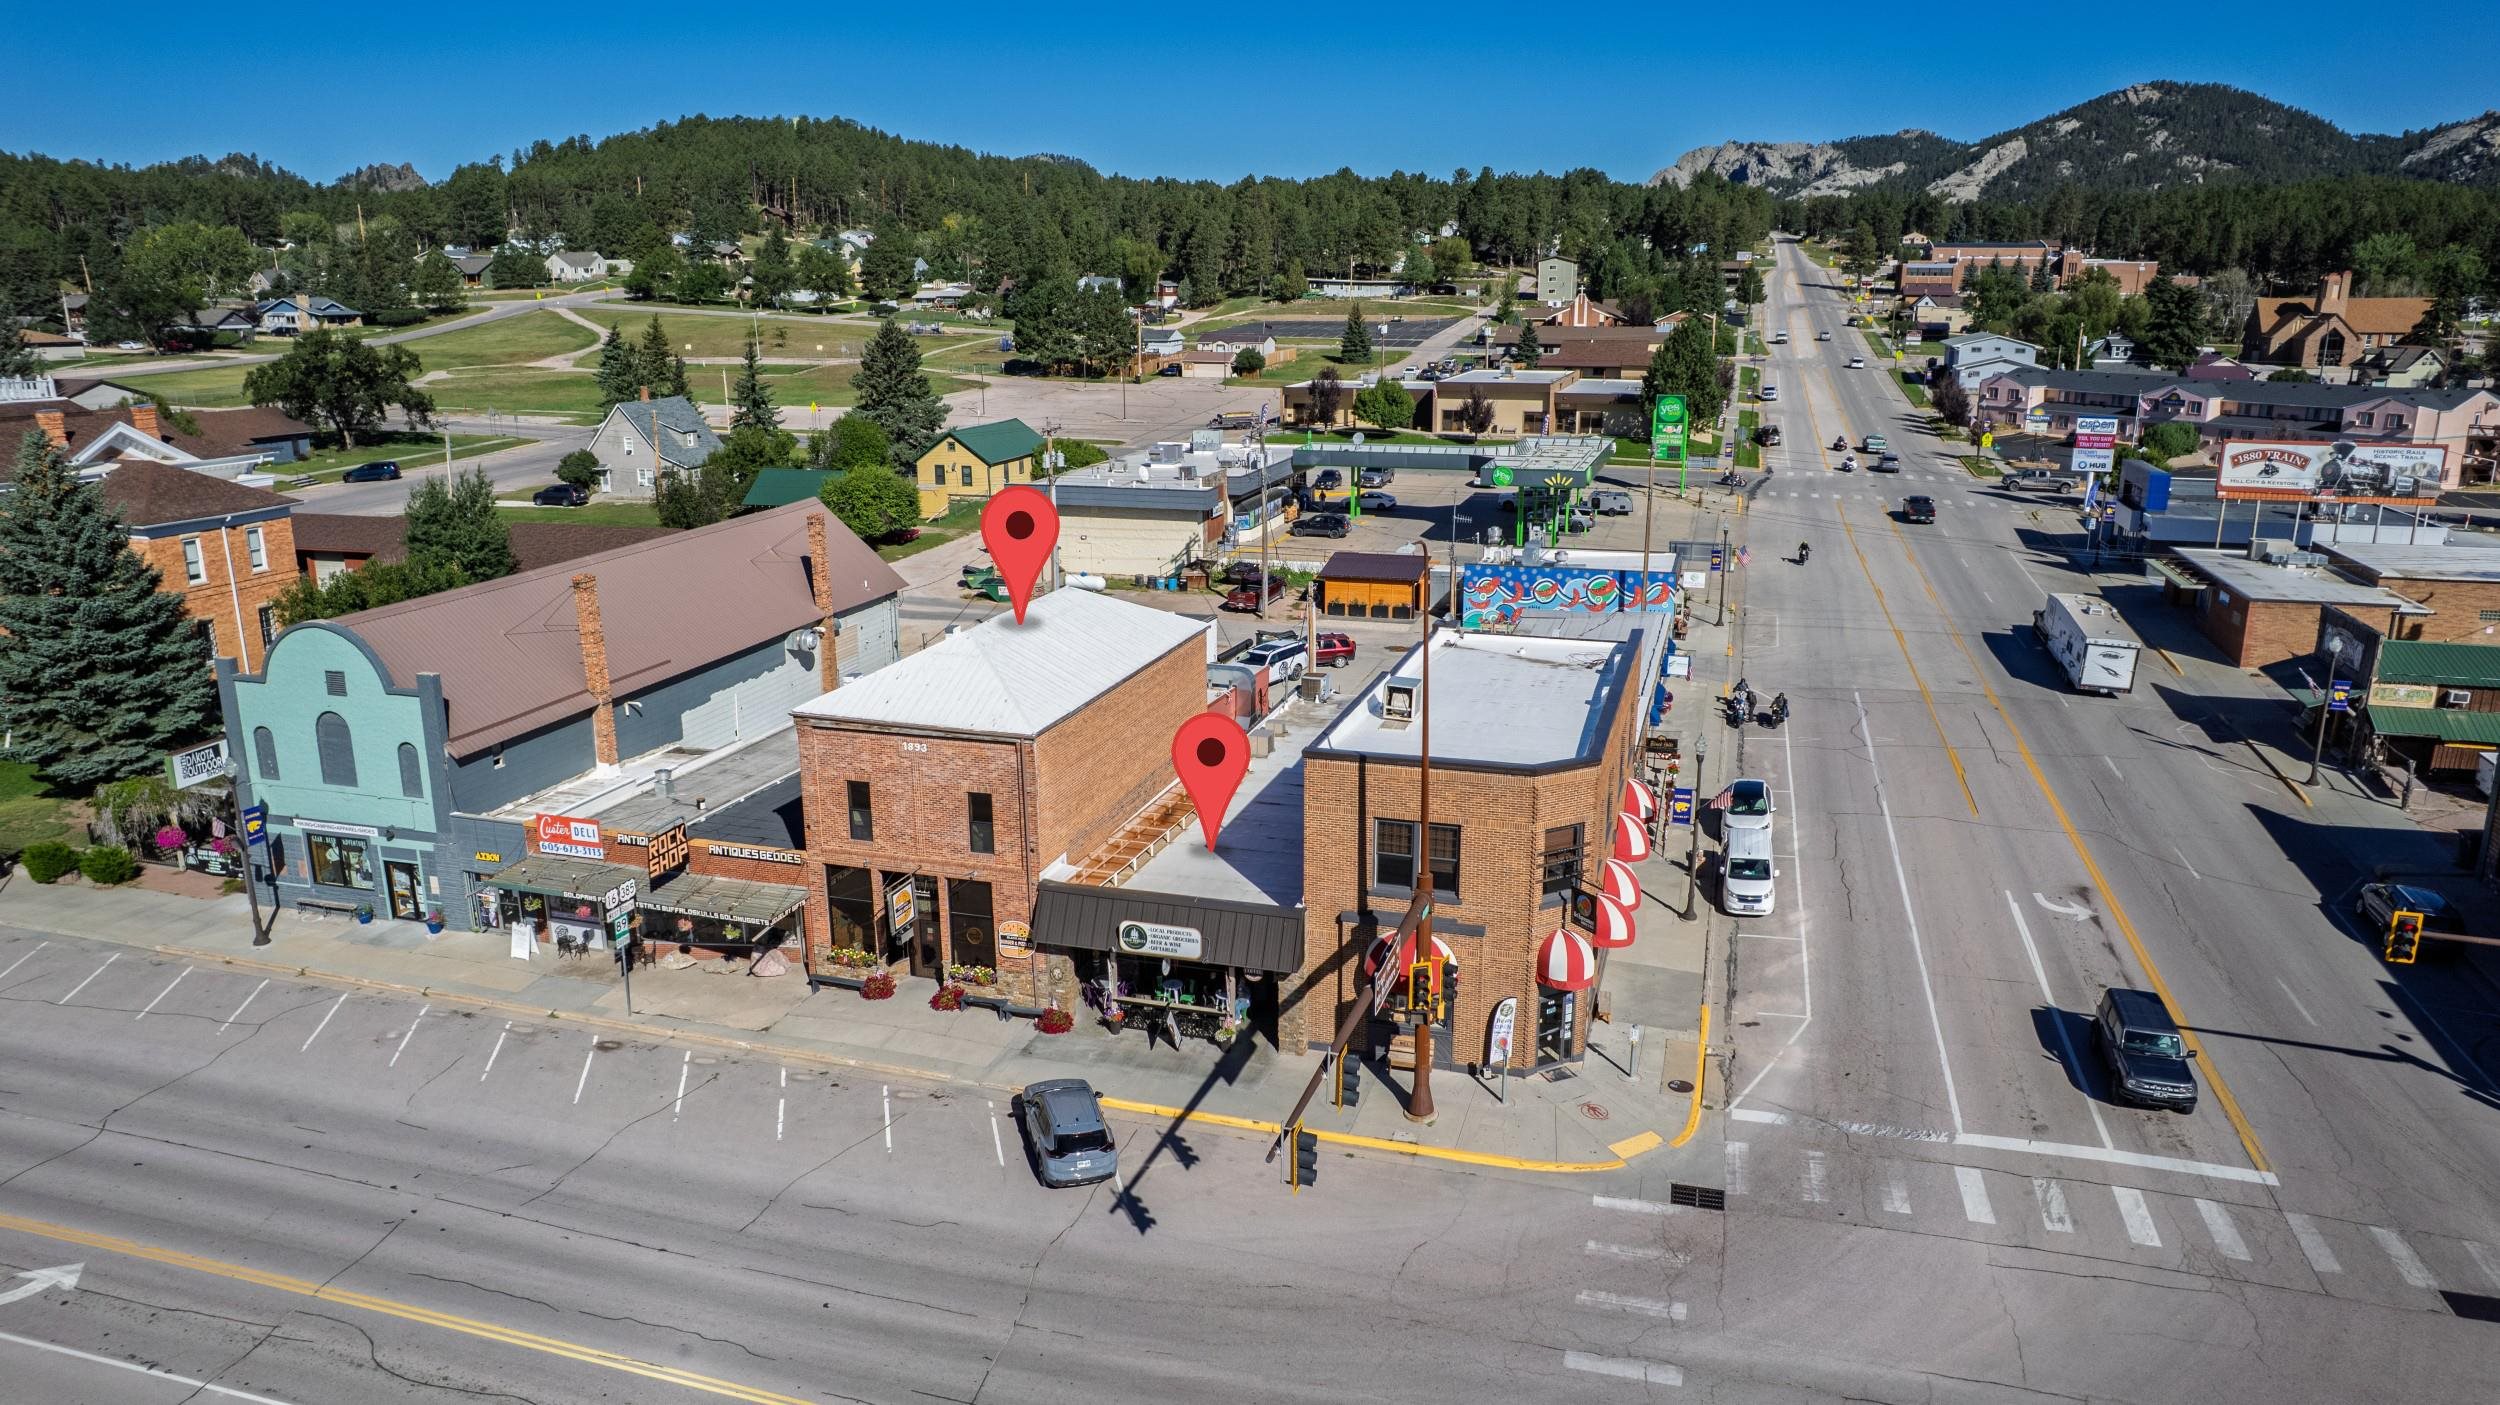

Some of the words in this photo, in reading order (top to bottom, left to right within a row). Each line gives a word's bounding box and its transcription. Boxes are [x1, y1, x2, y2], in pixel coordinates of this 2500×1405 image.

[1660, 404, 1680, 415] yes
[2079, 420, 2115, 432] aspen
[2239, 451, 2262, 463] 1880
[2264, 450, 2304, 466] TRAIN
[902, 741, 928, 752] 1893
[187, 748, 215, 766] DAKOTA
[188, 757, 223, 777] OUTDOOR
[540, 817, 571, 839] Custer
[574, 826, 596, 839] DELI
[617, 834, 649, 846] ANTIQ
[649, 824, 687, 860] ROCK
[541, 843, 602, 857] 605-673-3113
[708, 844, 758, 859] ANTIQUES
[760, 849, 801, 864] GEODES
[649, 844, 688, 878] SHOP
[620, 882, 635, 900] 385
[607, 893, 617, 906] 16
[616, 918, 627, 932] 89
